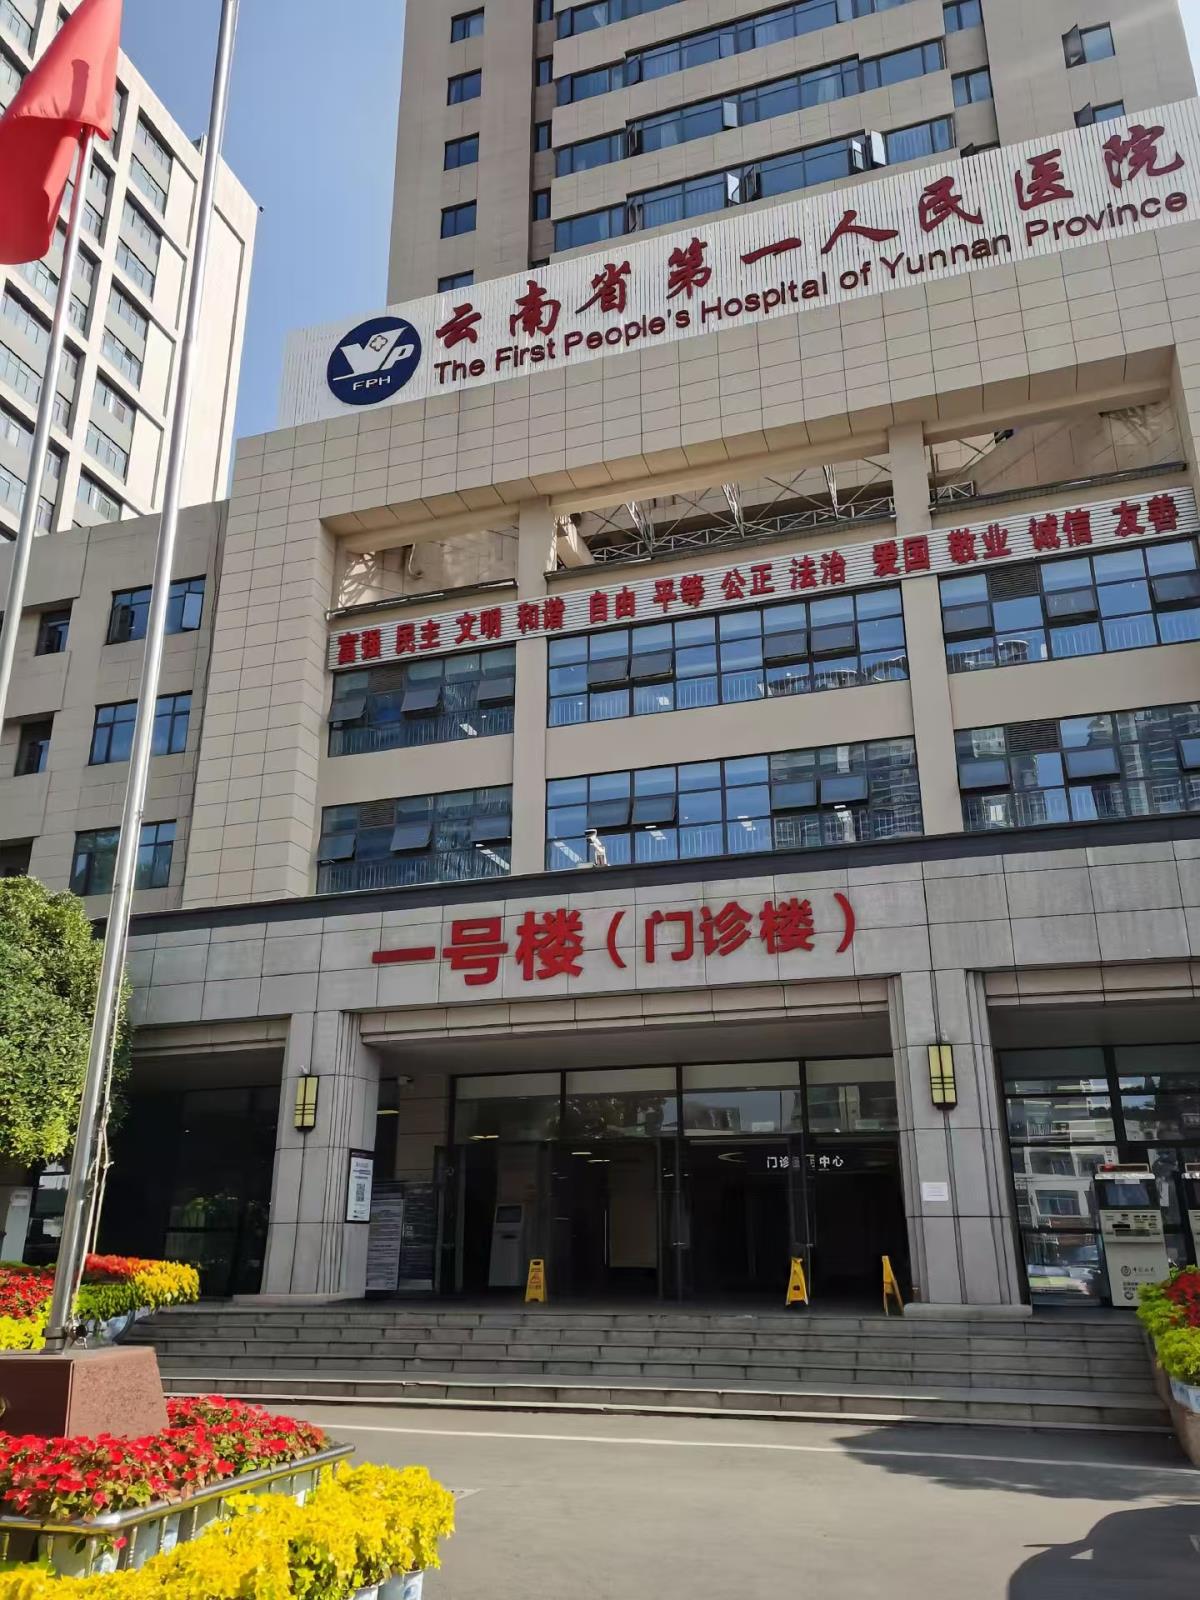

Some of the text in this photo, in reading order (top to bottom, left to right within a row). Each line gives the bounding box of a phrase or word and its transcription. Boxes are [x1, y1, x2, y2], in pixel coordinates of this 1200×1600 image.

[434, 191, 1188, 384] The First People's Hospital of Yunnan Province
[435, 124, 1185, 348] 云南省第一人民医院
[352, 375, 391, 391] FPH
[338, 493, 1180, 664] 富强 民主 文明 和谐 自由 平等 公正 法治 爱国 敬业 诚信 友善
